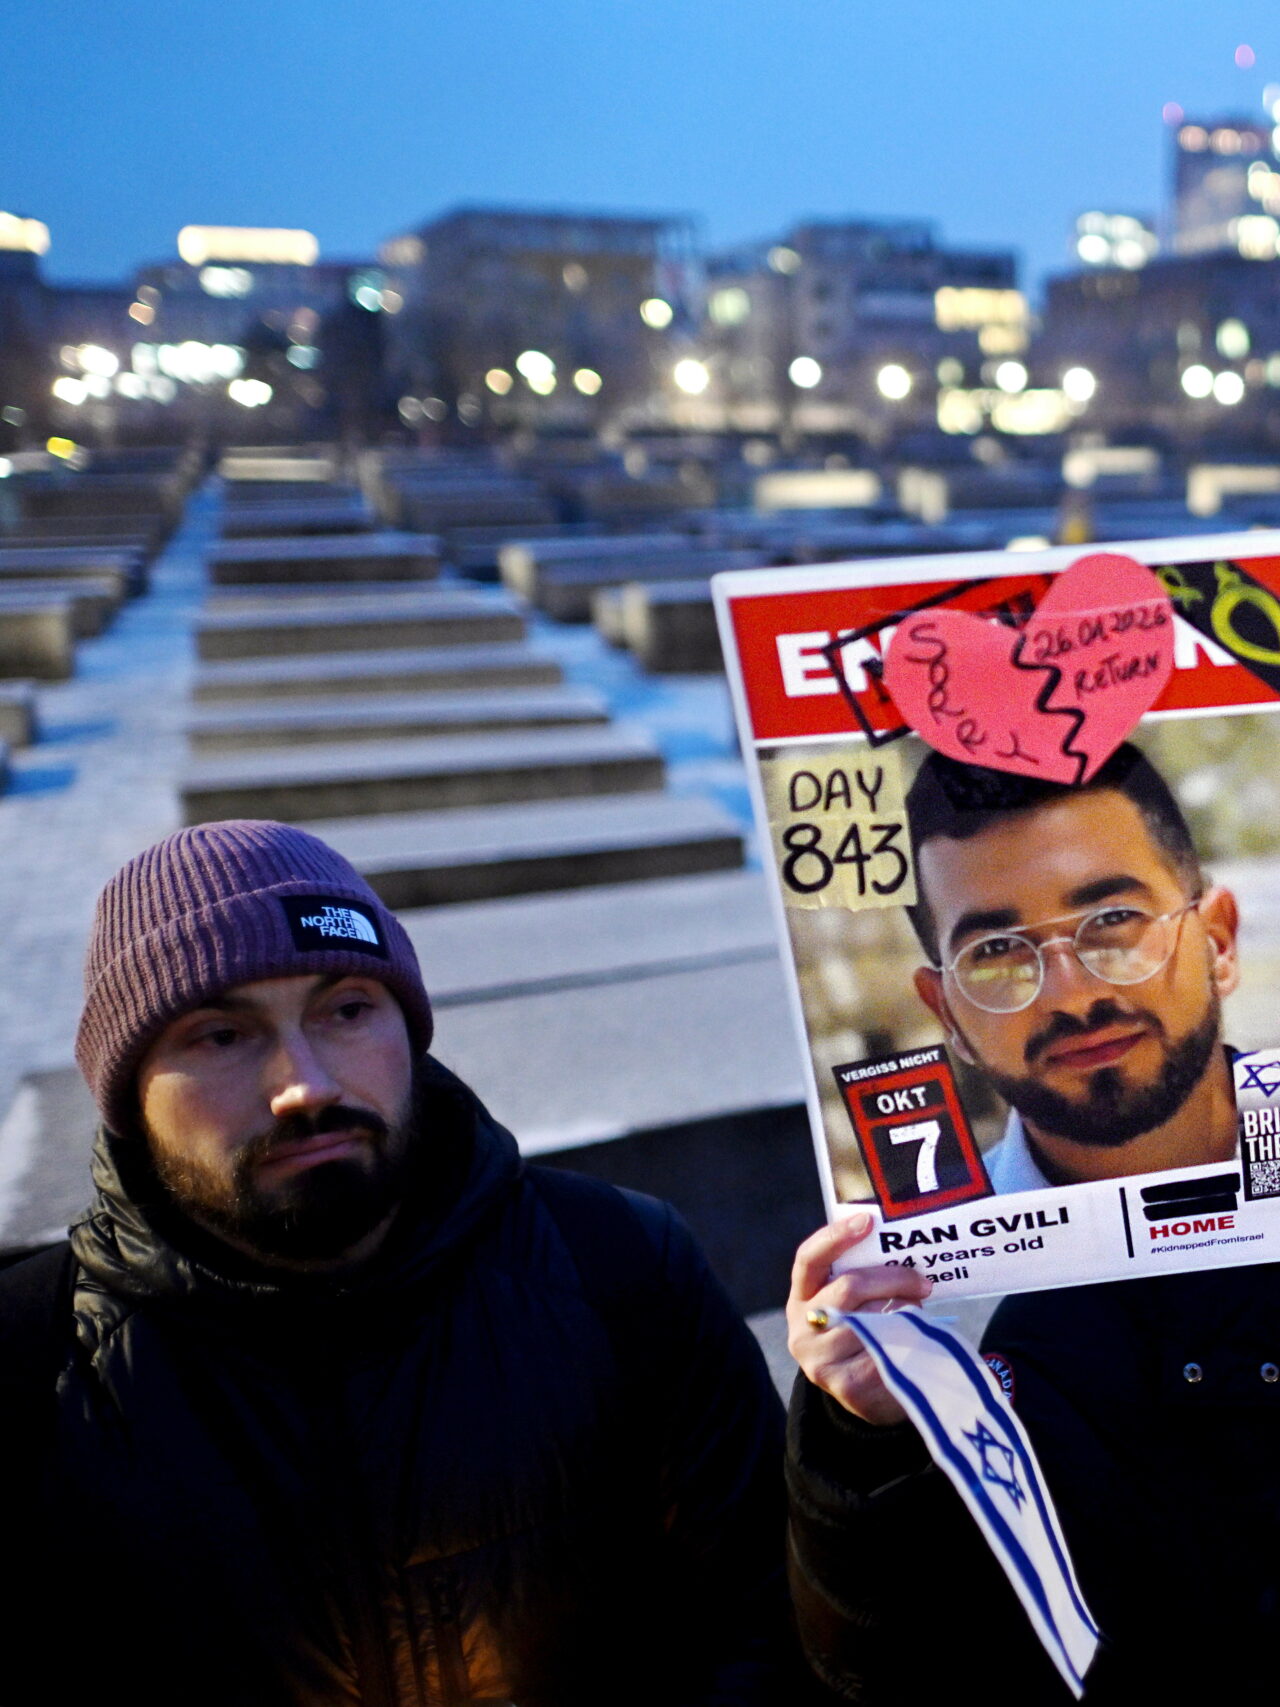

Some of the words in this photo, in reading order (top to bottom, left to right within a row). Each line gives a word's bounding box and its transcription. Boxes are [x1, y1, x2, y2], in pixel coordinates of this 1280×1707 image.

[904, 622, 1040, 765] SORRY
[789, 766, 883, 813] DAY
[783, 823, 907, 896] 843
[300, 916, 354, 928] NORTH
[321, 906, 351, 918] THE
[320, 926, 357, 939] FACE
[841, 1061, 898, 1083] VERGISS
[899, 1050, 940, 1068] NICHT
[876, 1087, 926, 1114] OKT
[888, 1120, 941, 1194] 7
[879, 1225, 959, 1253] RAN
[970, 1207, 1070, 1237] GVILI
[1149, 1215, 1236, 1240] HOME
[1150, 1233, 1265, 1254] #KidnappedFromIsrael
[923, 1245, 996, 1268] years
[1003, 1236, 1044, 1253] old
